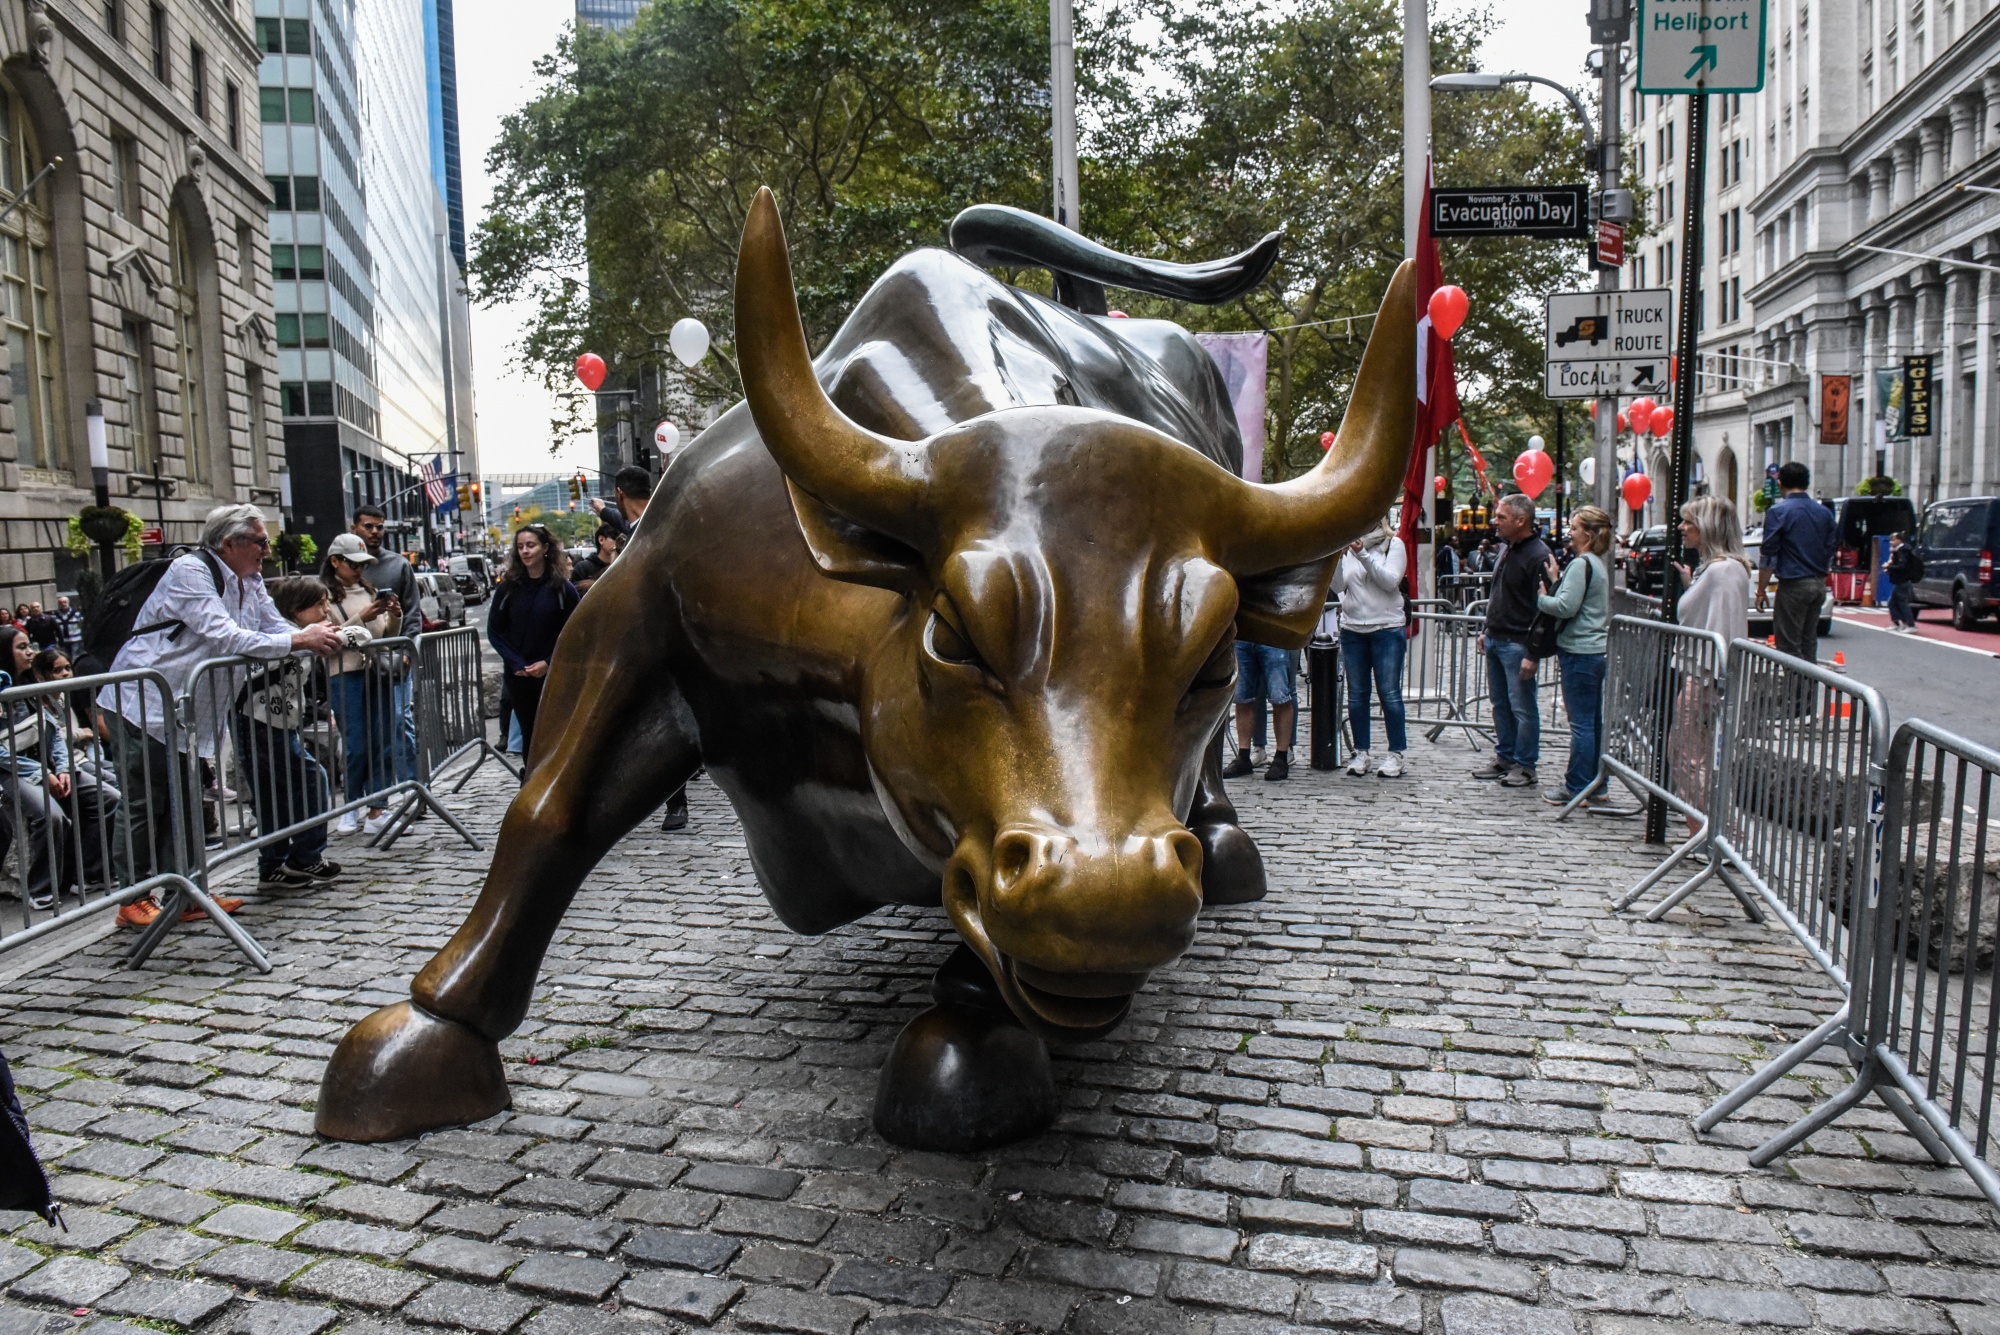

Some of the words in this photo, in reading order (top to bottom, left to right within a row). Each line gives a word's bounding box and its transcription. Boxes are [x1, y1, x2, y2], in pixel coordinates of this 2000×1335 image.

[1654, 11, 1749, 34] Heliport
[1468, 194, 1505, 204] November
[1526, 193, 1544, 203] 1783
[1439, 202, 1534, 222] Evacuation
[1539, 201, 1572, 224] Day
[1493, 219, 1518, 229] PLAZA
[1616, 308, 1663, 324] TRUCK
[1615, 335, 1663, 351] ROUTE
[1561, 371, 1609, 386] LOCAL
[1909, 367, 1928, 425] GIFTS
